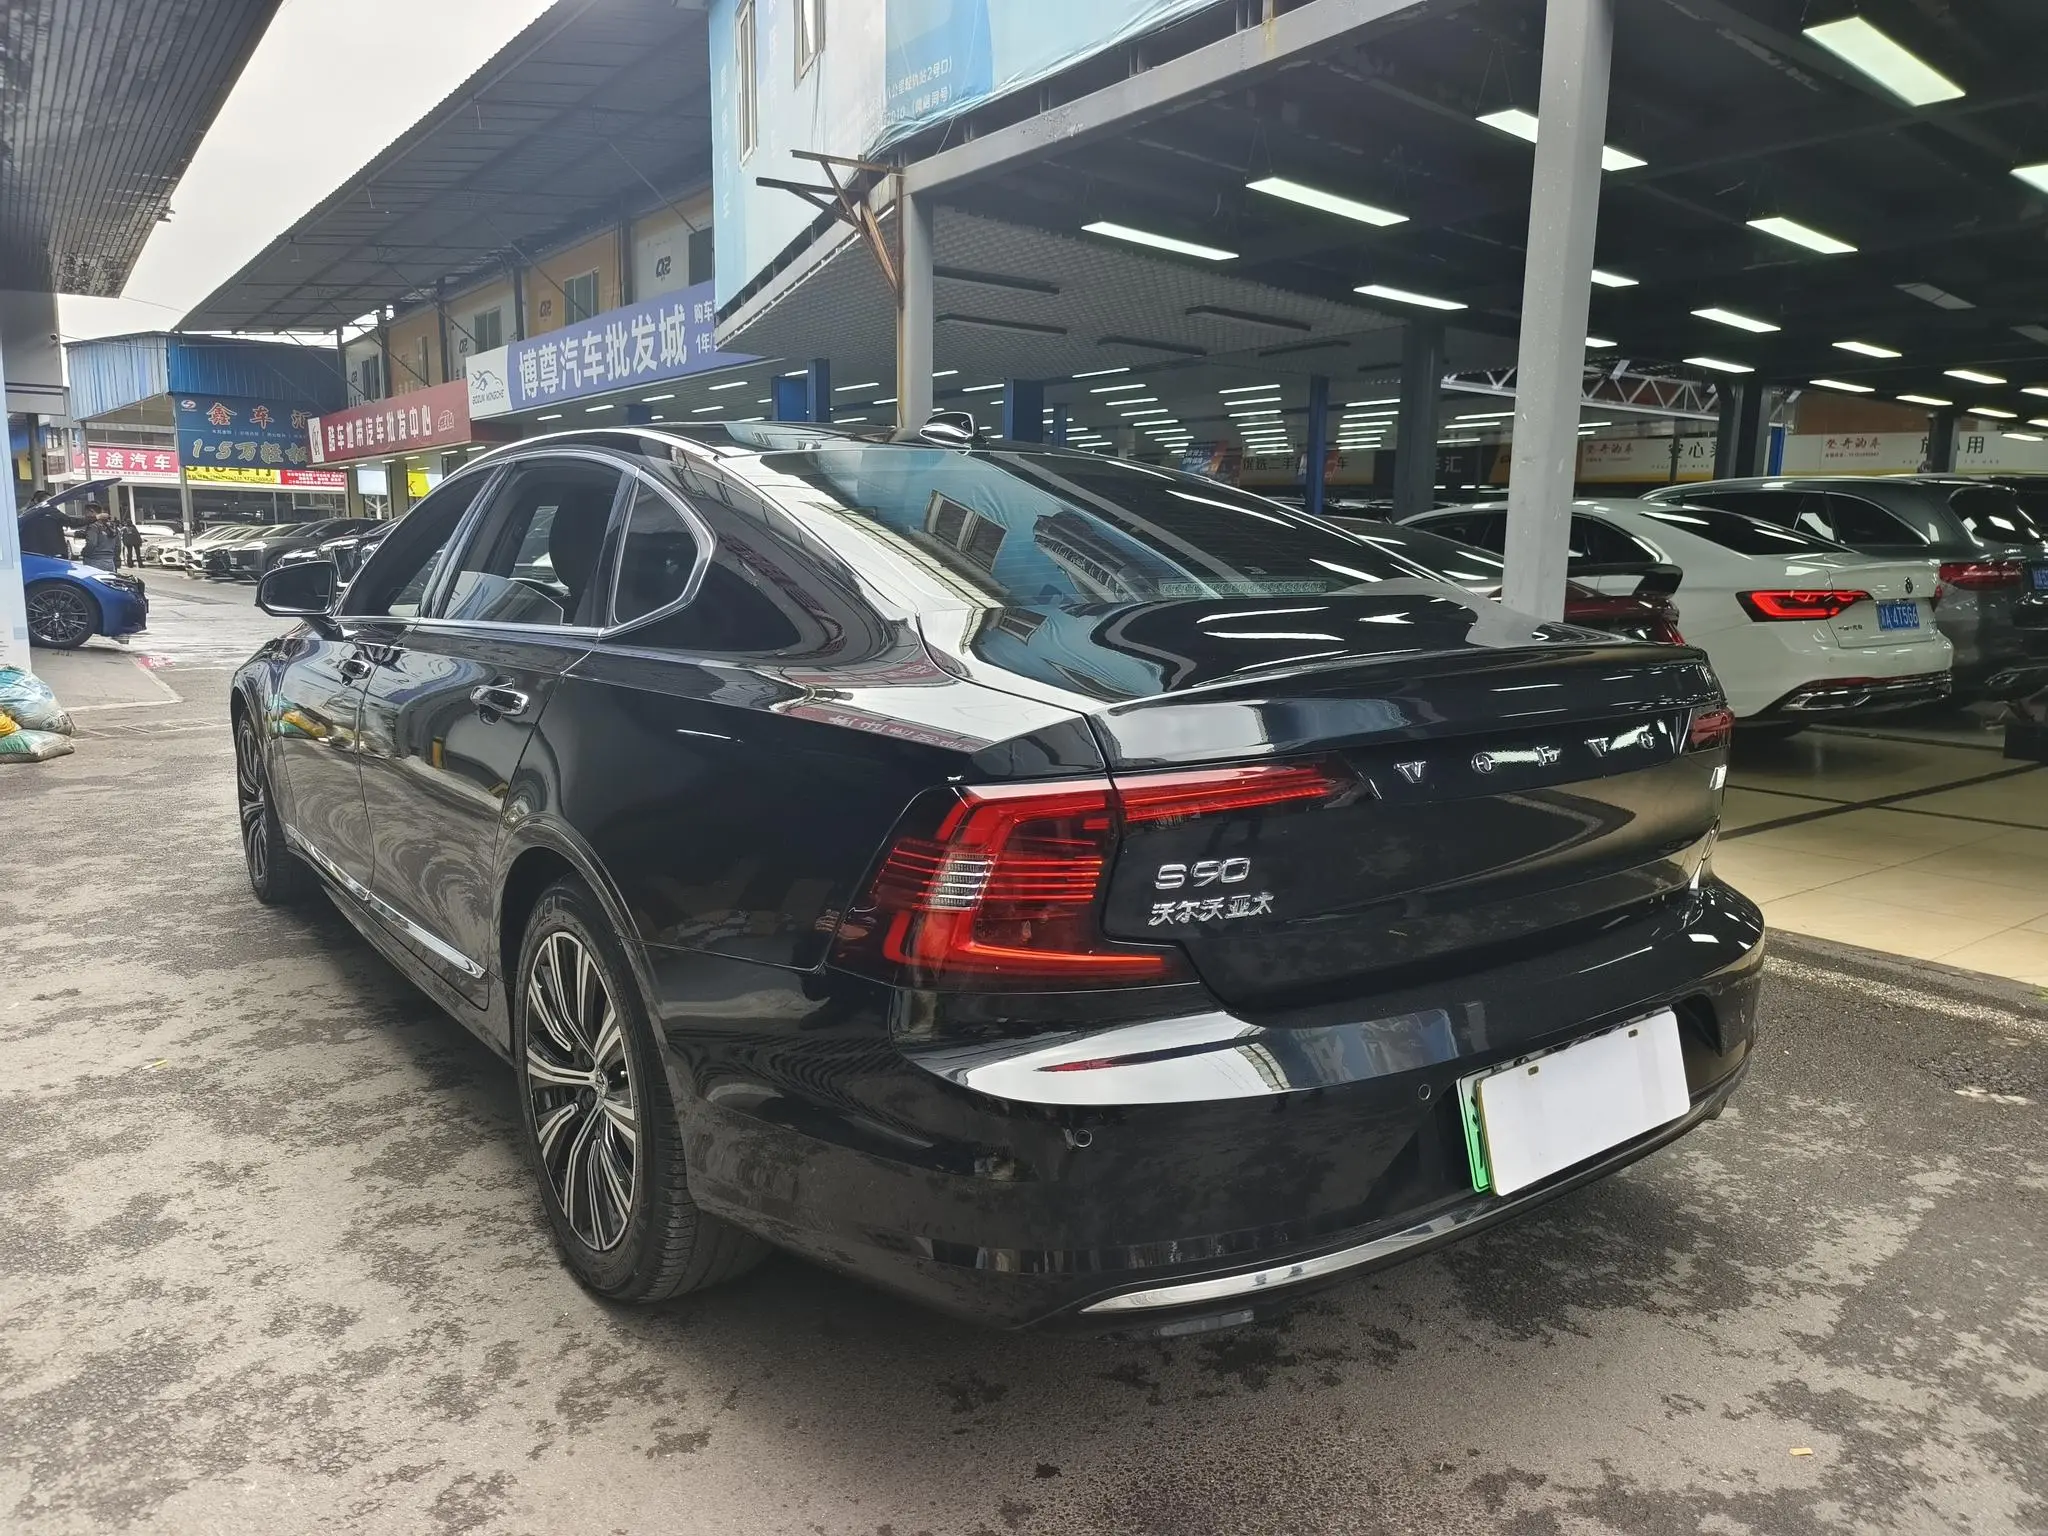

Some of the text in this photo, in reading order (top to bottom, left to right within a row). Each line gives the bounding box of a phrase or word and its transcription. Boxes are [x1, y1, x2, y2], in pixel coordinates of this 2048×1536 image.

[694, 300, 718, 324] 购车
[518, 303, 688, 402] 博尊汽车批发城
[1155, 857, 1251, 890] S90
[1148, 891, 1275, 926] 沃尔沃亚太
